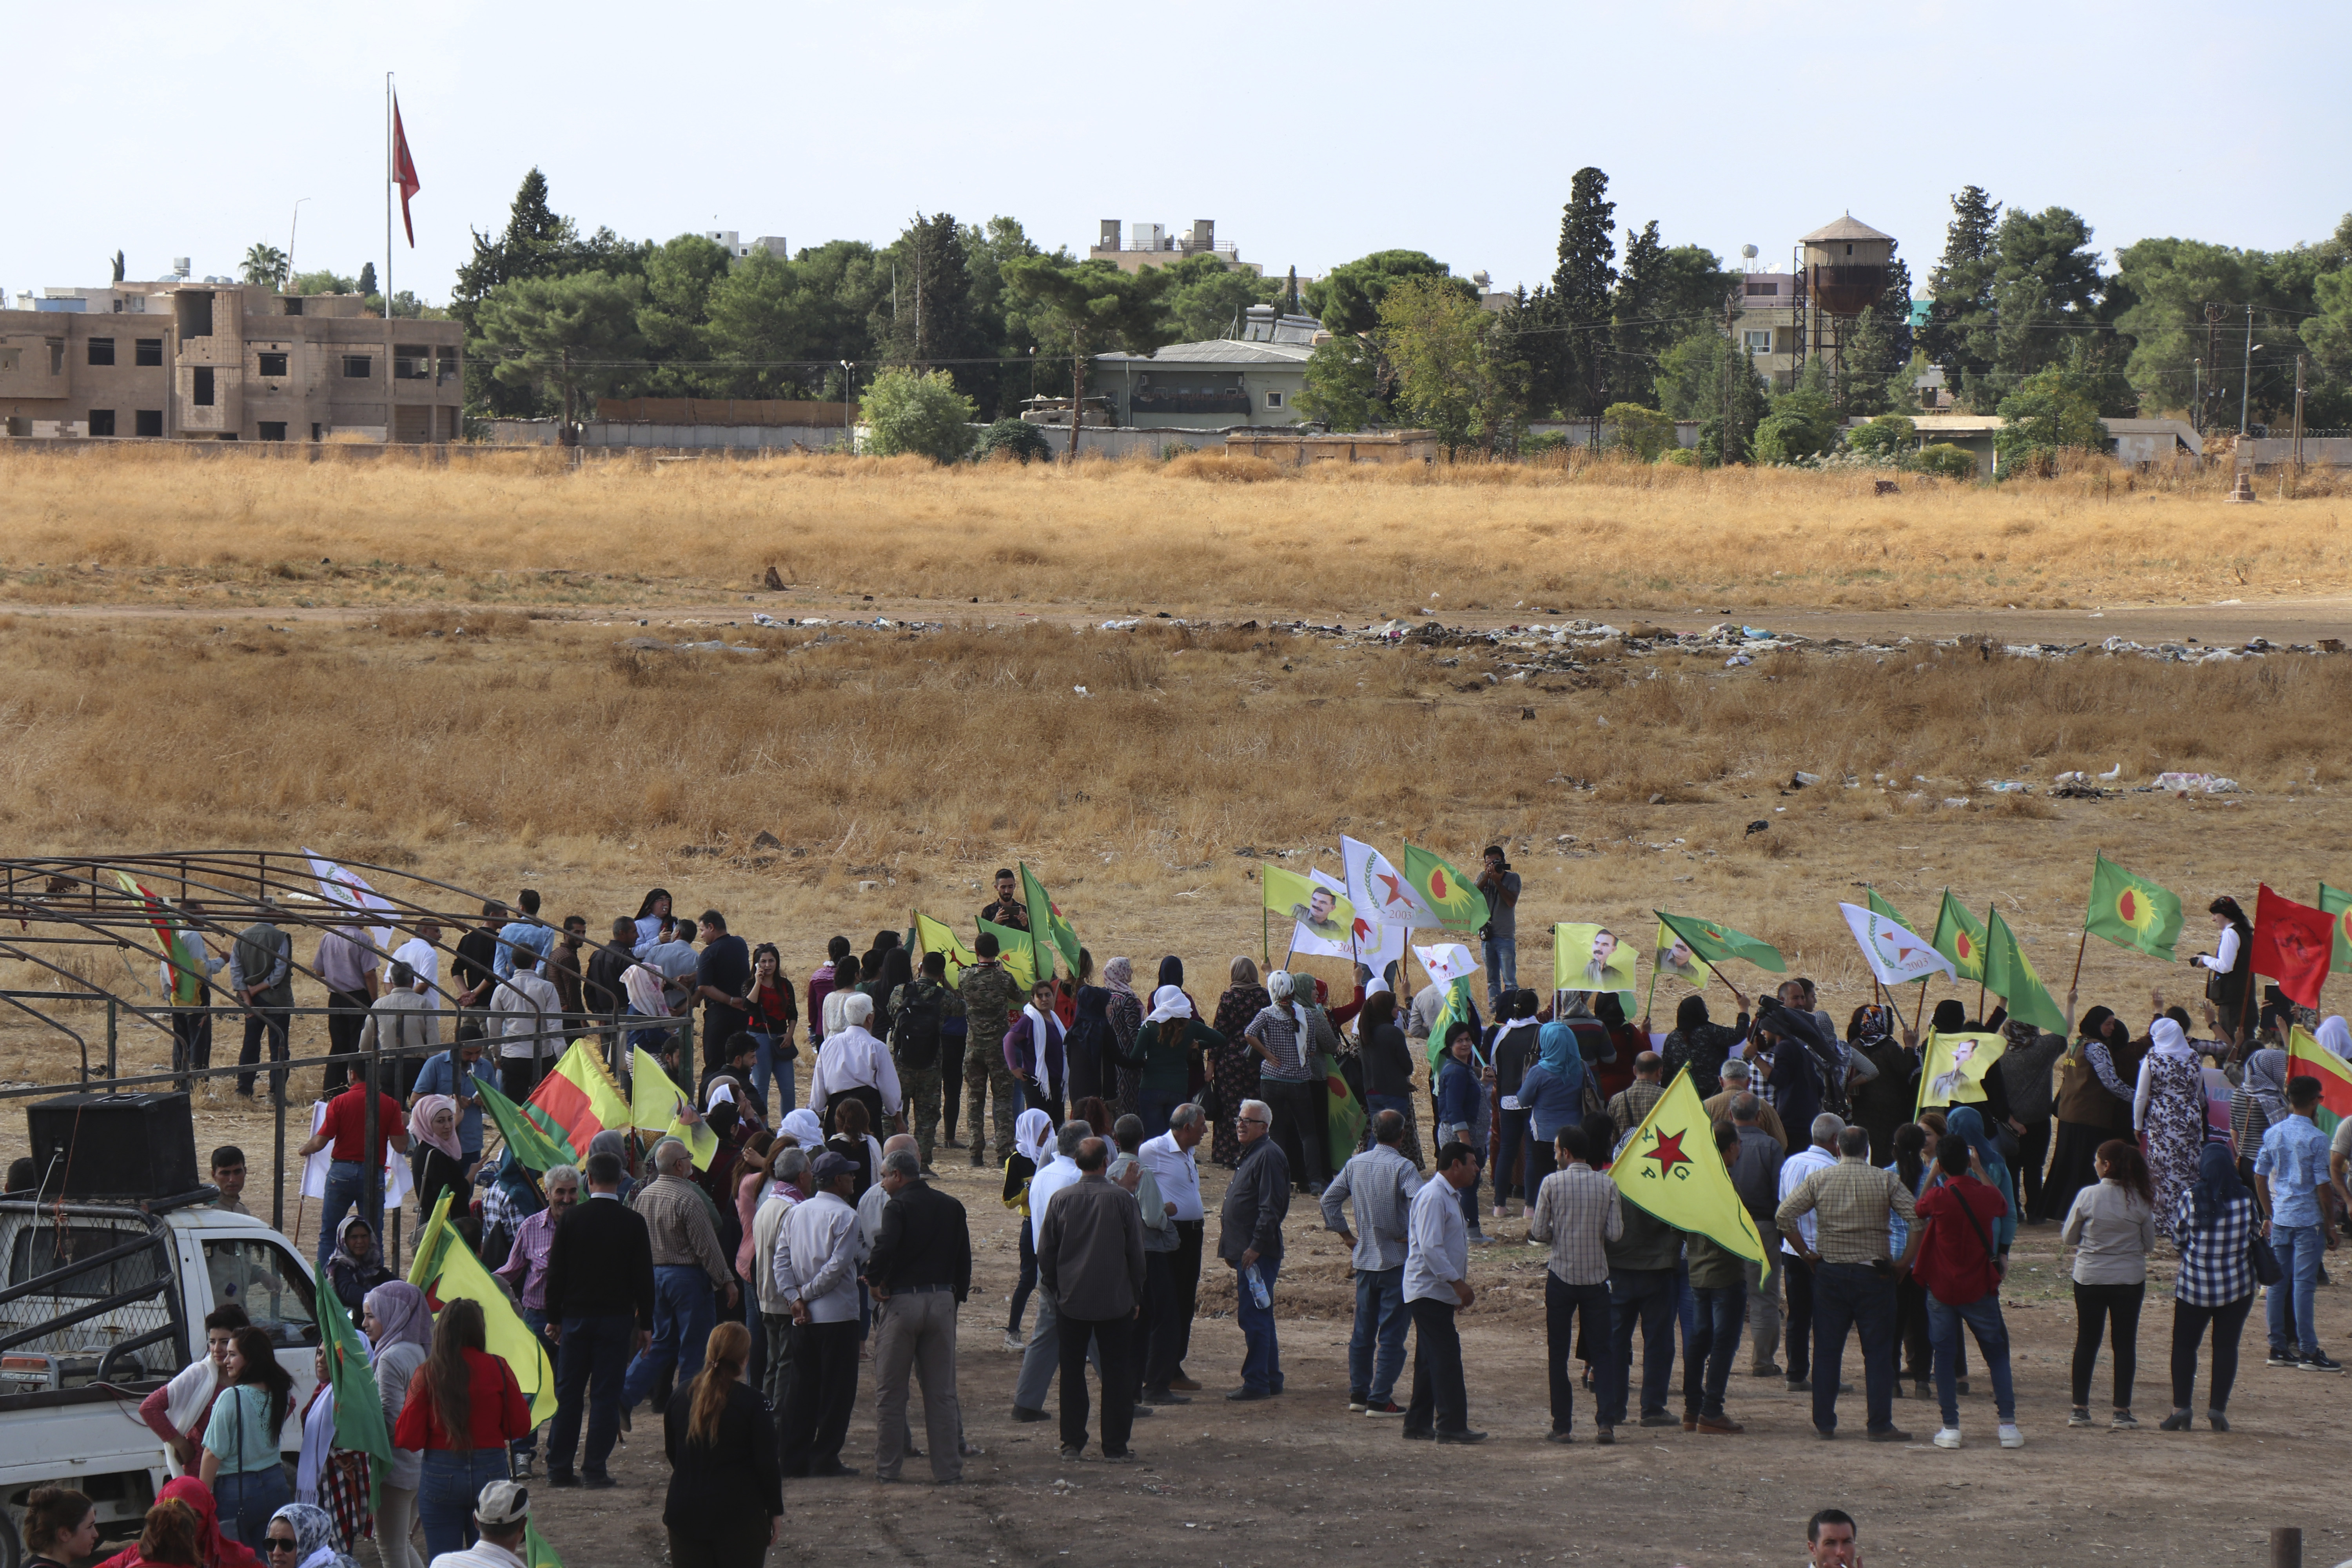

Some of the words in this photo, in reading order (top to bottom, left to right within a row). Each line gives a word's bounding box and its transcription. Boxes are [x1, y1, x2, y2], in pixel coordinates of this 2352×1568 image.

[1389, 909, 1412, 920] 2003
[1337, 942, 1362, 955] 2003
[1906, 958, 1929, 972] 2003
